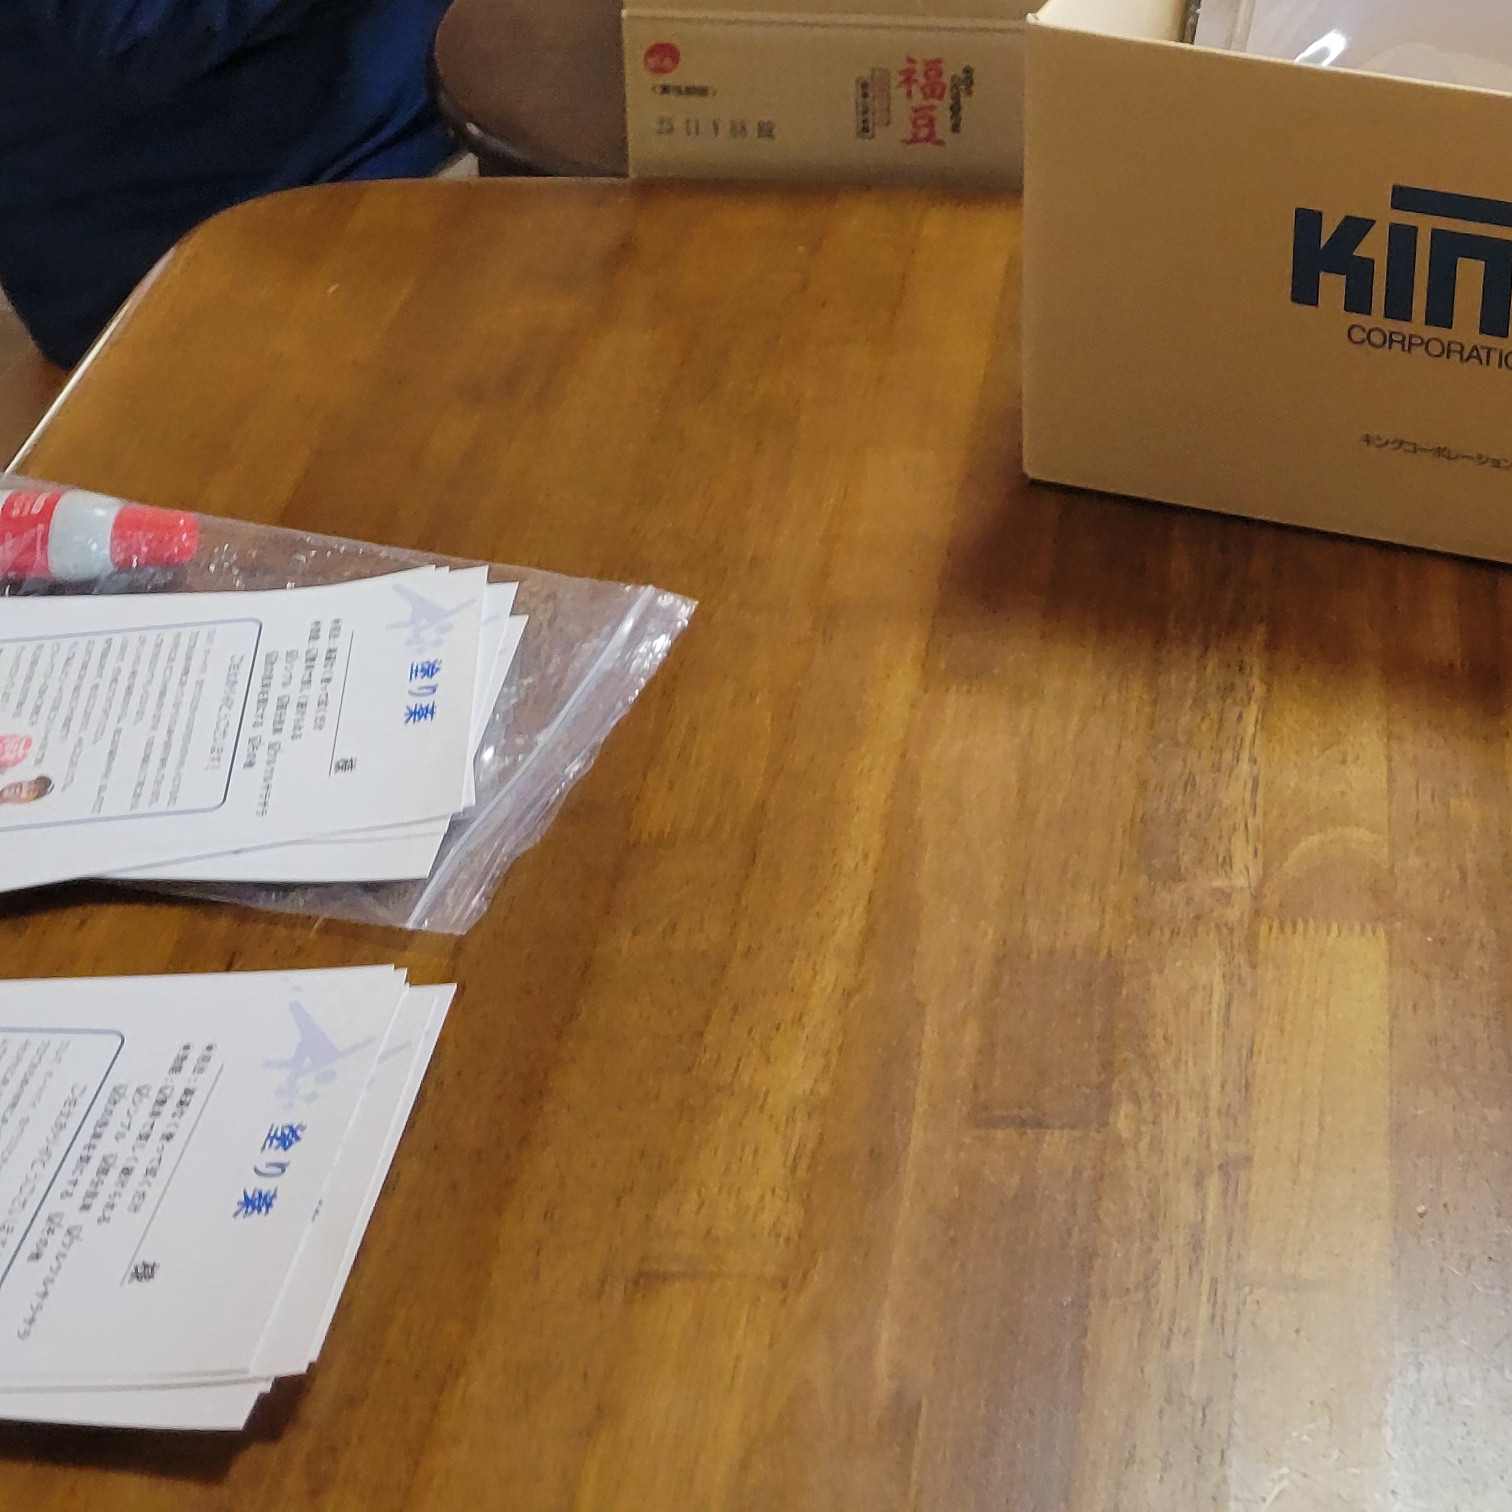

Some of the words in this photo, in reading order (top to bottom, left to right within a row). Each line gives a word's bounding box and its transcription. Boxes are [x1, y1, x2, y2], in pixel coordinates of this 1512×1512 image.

[897, 55, 948, 148] 福豆
[404, 658, 444, 726] 塗り薬
[233, 1122, 307, 1219] 塗り薬
